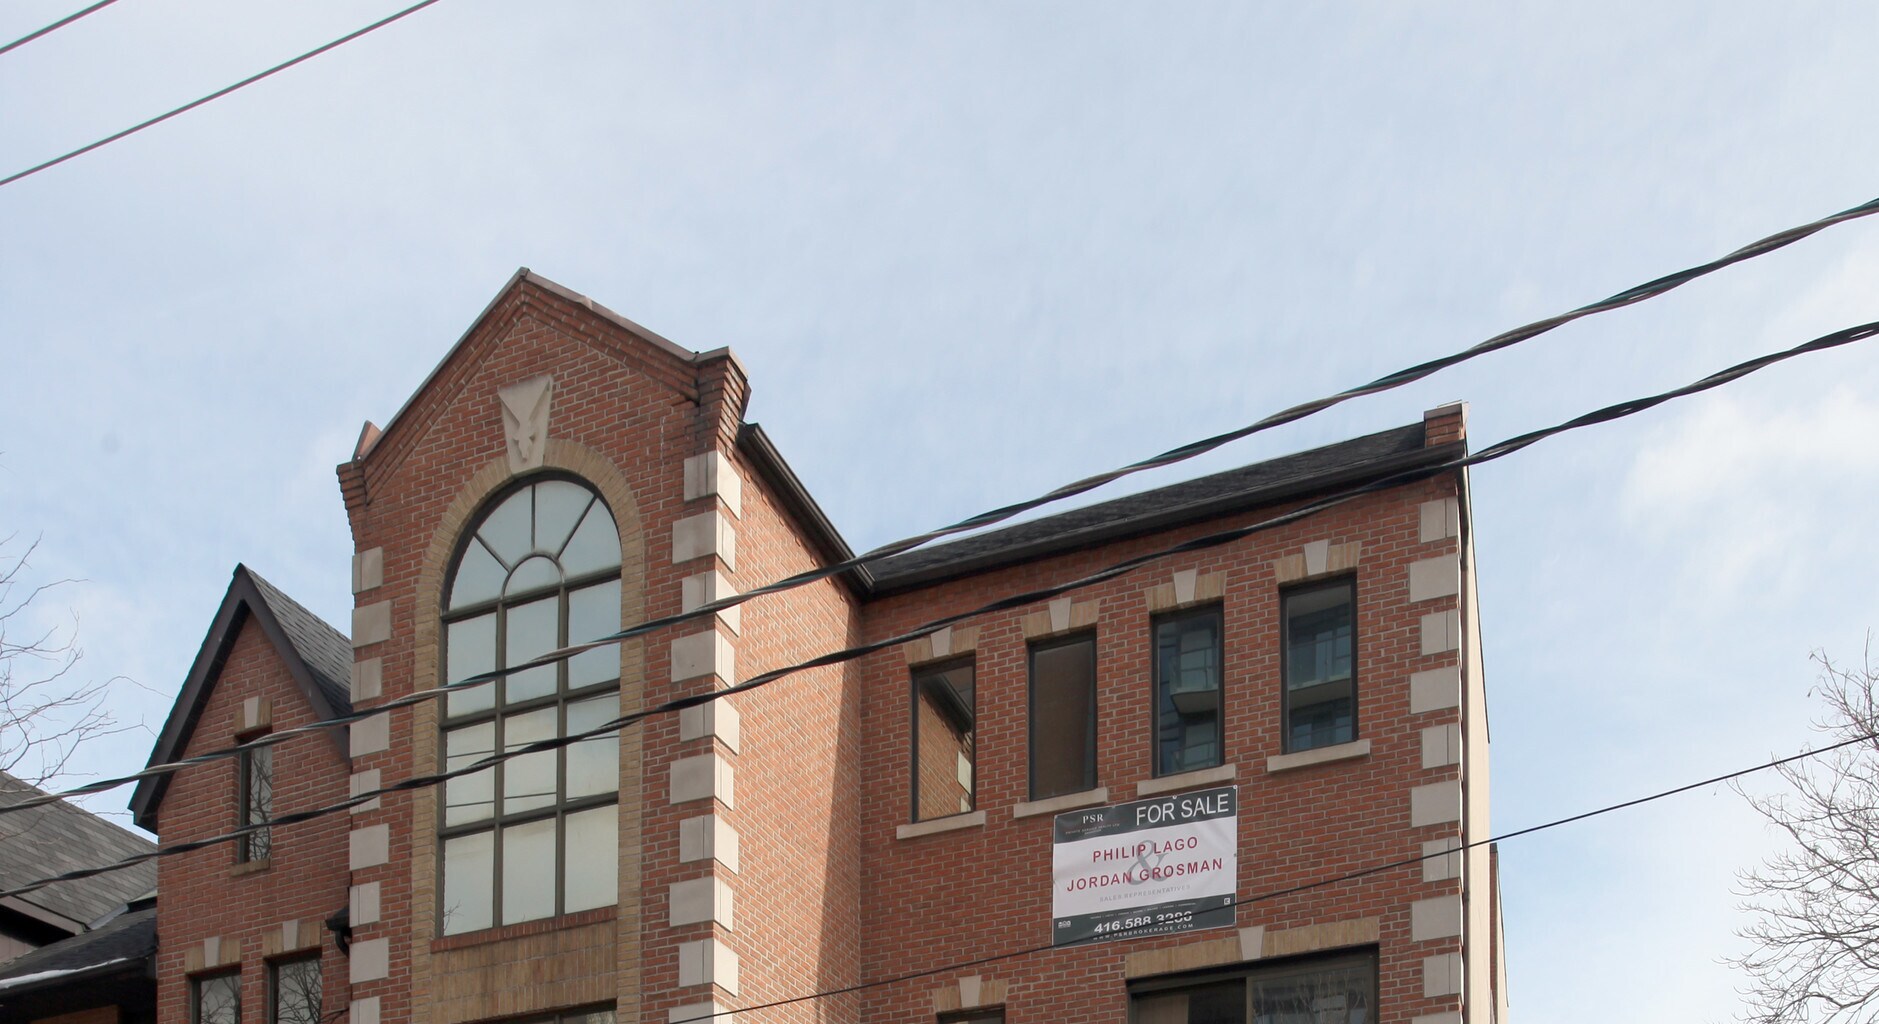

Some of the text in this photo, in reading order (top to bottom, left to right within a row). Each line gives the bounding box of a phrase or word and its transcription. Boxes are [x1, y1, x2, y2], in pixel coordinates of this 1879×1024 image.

[1082, 813, 1104, 824] PSR
[1136, 794, 1229, 826] FOR SALE
[1093, 836, 1198, 863] PHILIP LAGO
[1066, 858, 1223, 892] JORDAN GROSMAN
[1099, 884, 1191, 903] SALES REPRESENTATIVES
